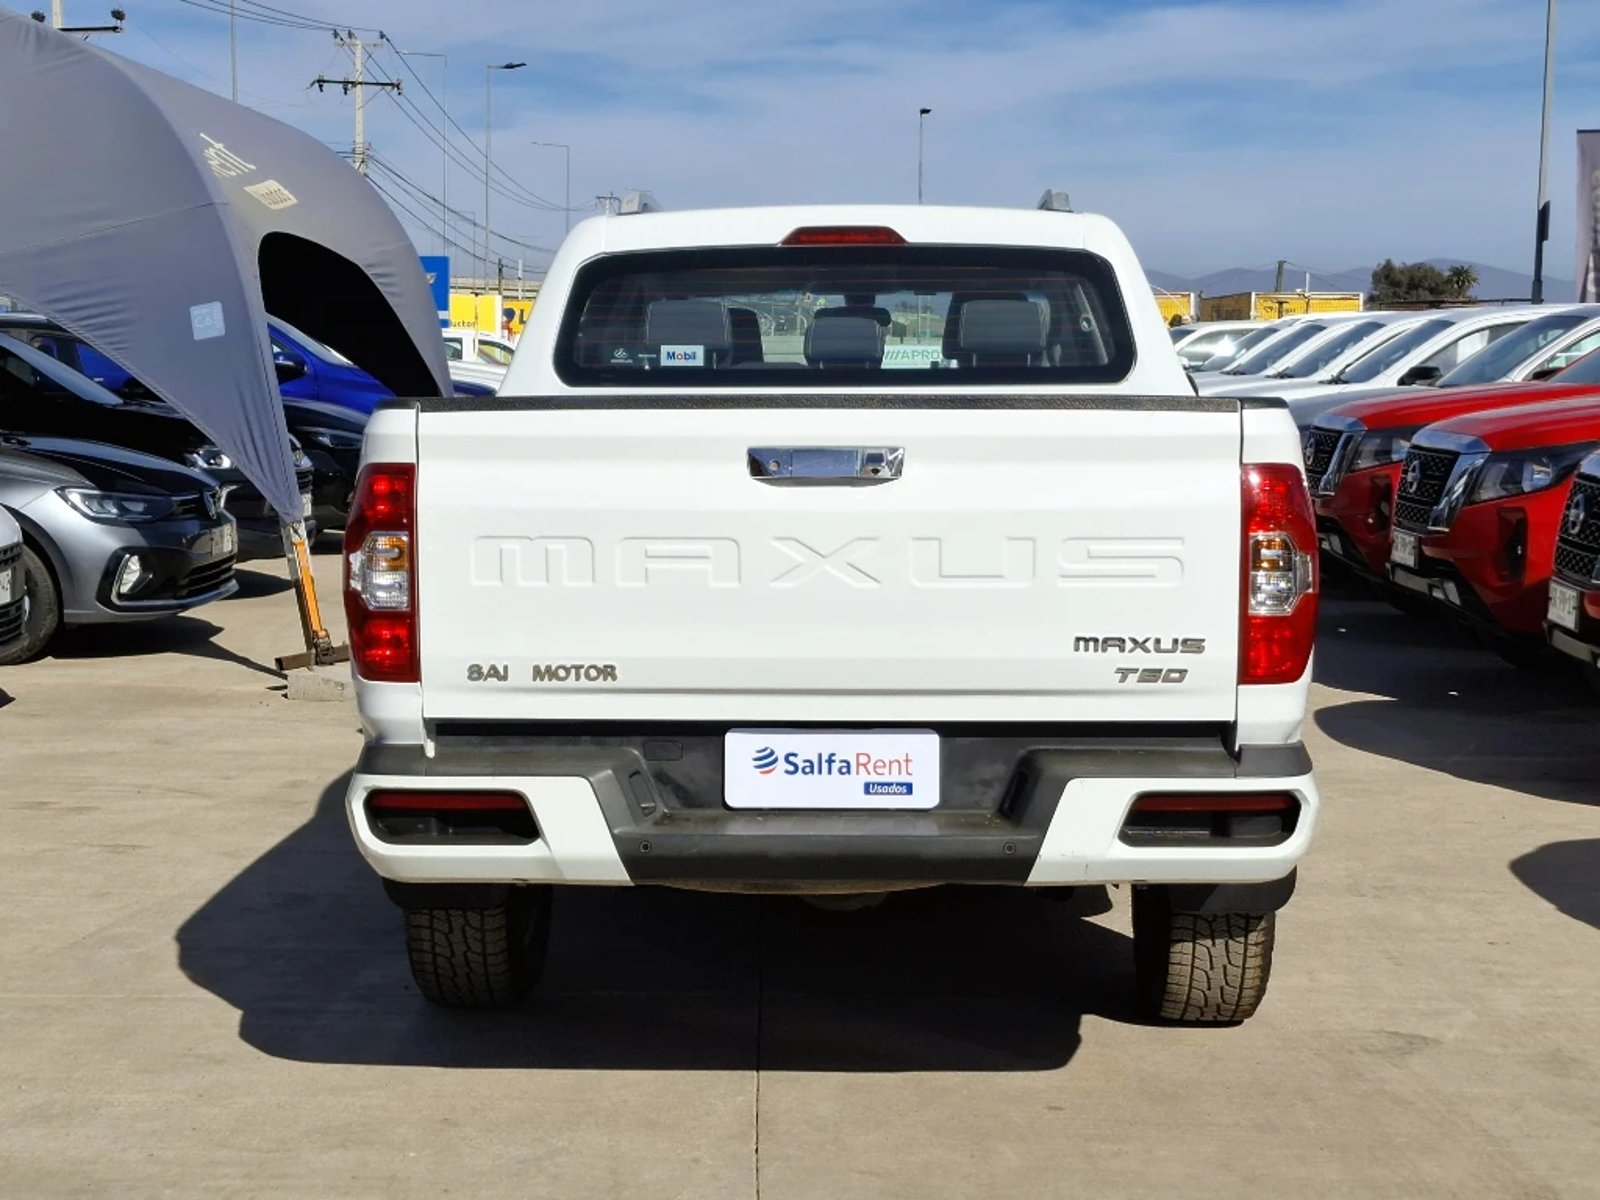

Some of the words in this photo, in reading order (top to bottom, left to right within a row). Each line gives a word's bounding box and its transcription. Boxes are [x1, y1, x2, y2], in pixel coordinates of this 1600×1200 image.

[666, 350, 697, 361] Mobil
[469, 536, 1185, 589] MAXUS
[1073, 636, 1206, 653] MAXUS
[467, 663, 508, 682] SAI
[532, 664, 618, 682] MOTOR
[1114, 667, 1188, 683] T60
[784, 752, 913, 776] SalfaRent
[869, 782, 907, 794] Usados
